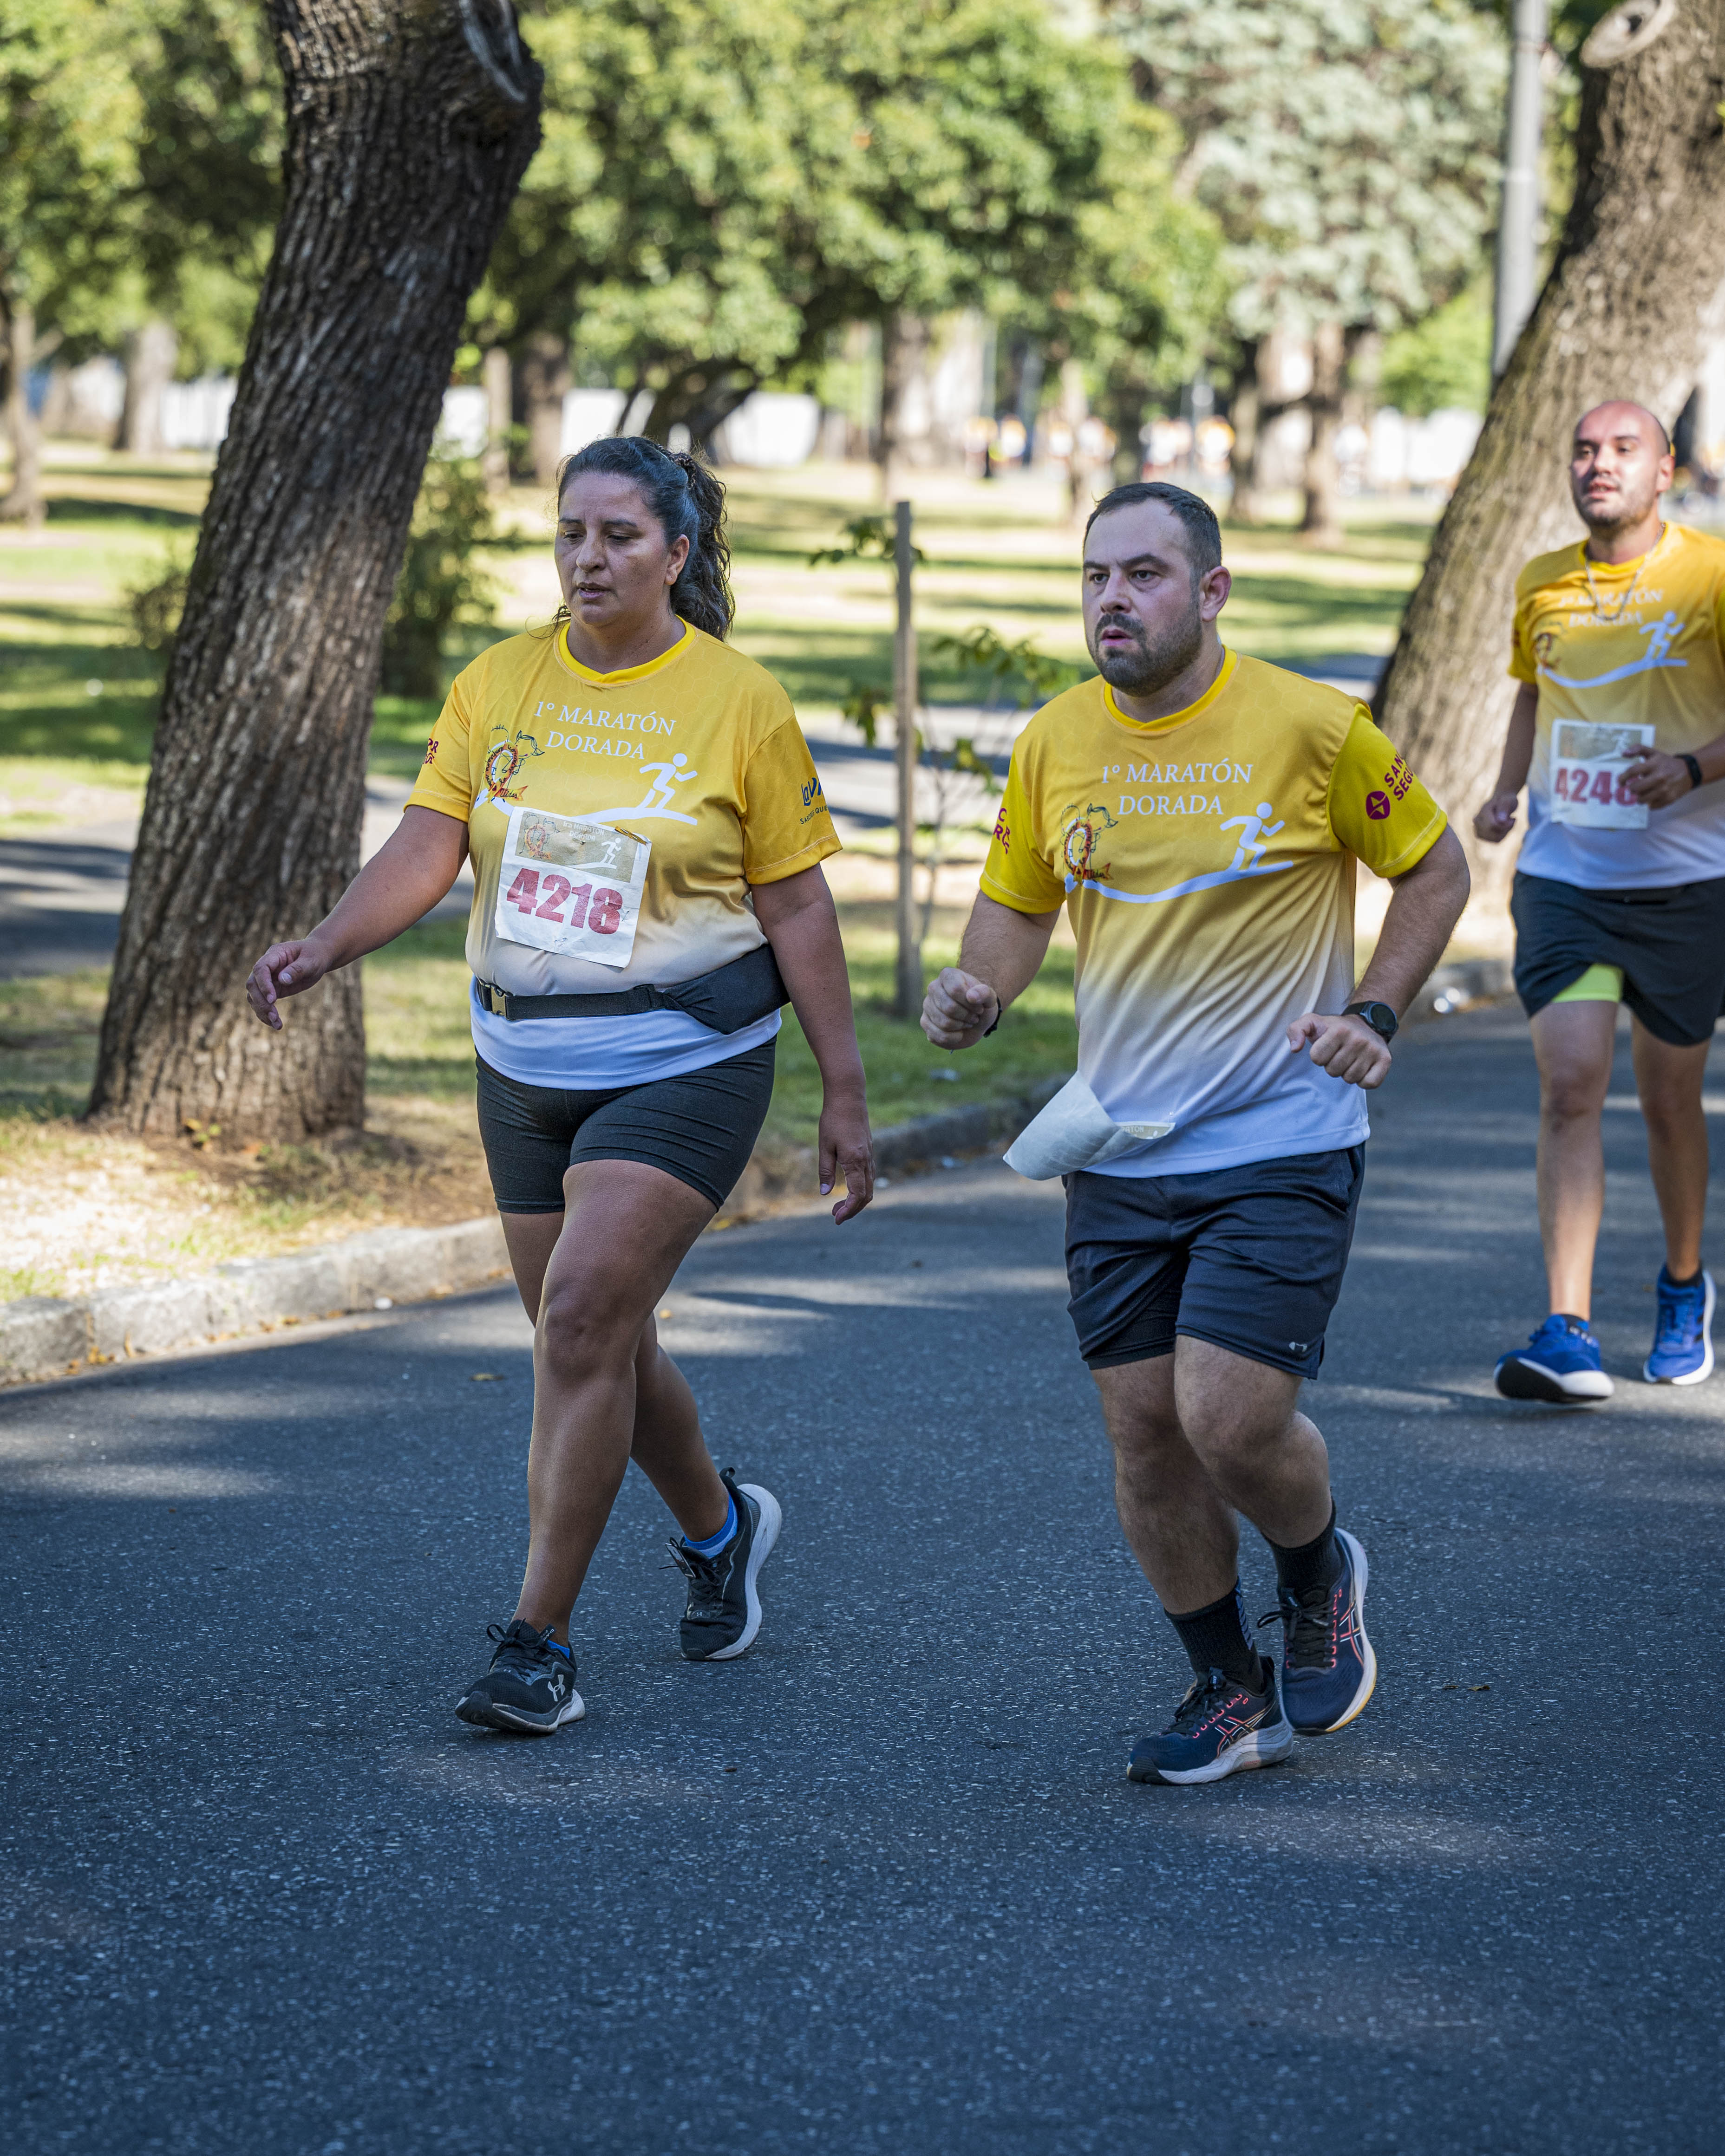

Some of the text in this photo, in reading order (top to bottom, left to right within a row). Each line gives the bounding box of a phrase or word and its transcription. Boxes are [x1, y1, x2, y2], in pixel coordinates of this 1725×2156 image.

[534, 701, 677, 736] 1° MARATÓN
[545, 731, 645, 760] DORADA
[1101, 757, 1254, 784] 1° MARATÓN
[1384, 752, 1404, 788] SAN
[815, 805, 828, 814] QUE
[1117, 795, 1224, 815] DORADA
[506, 867, 623, 935] 4218
